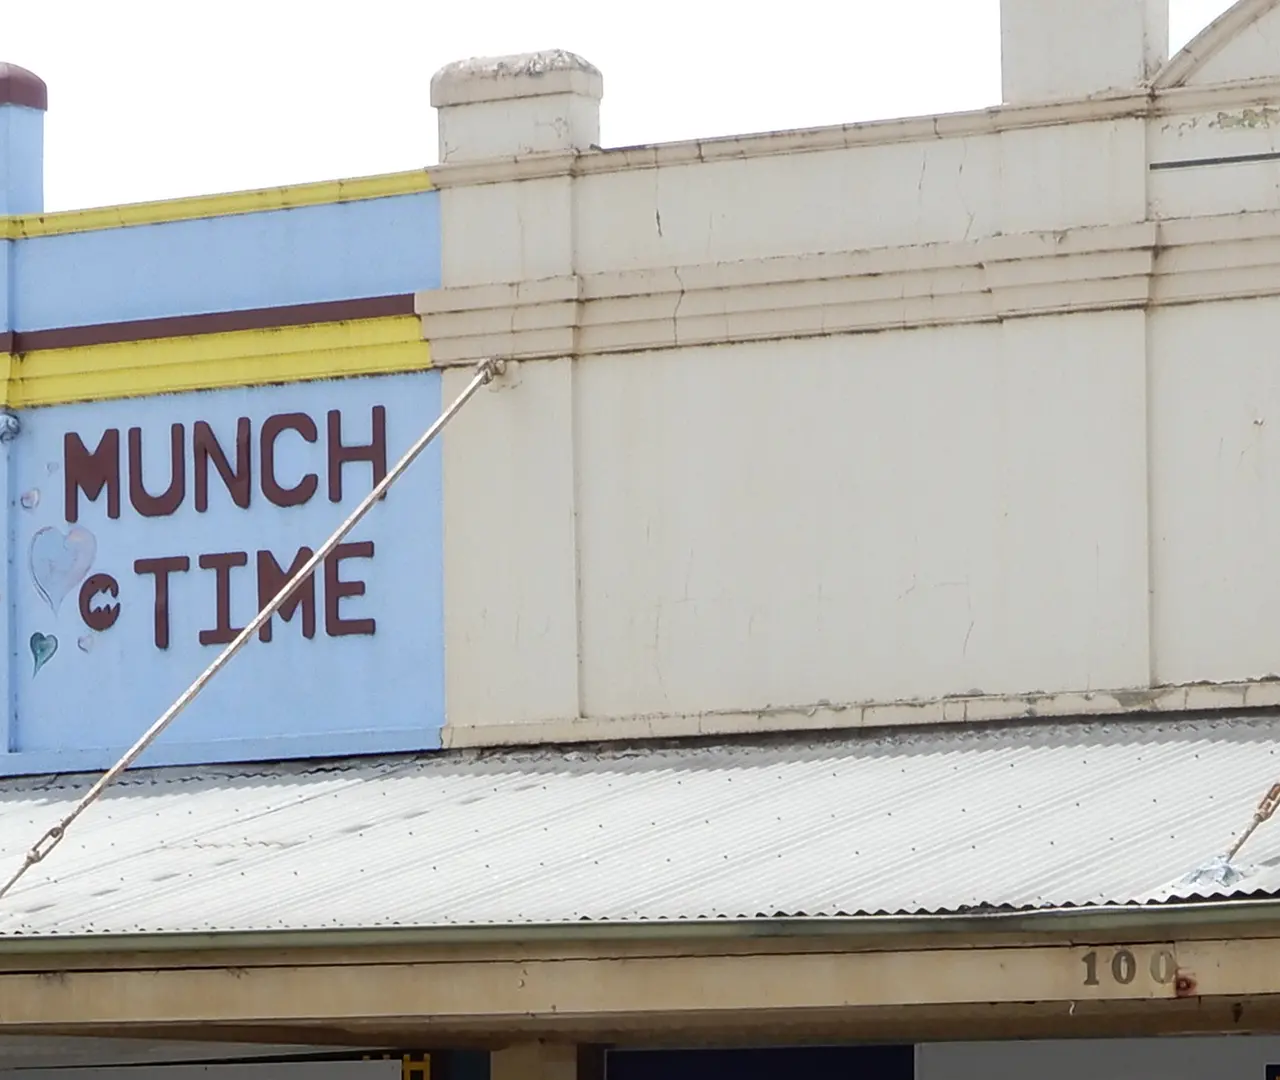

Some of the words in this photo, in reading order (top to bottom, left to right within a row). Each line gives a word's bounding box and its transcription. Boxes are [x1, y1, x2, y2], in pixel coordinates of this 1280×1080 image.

[63, 404, 389, 524] MUNCH
[133, 540, 377, 651] TIME
[1081, 950, 1177, 986] 100
